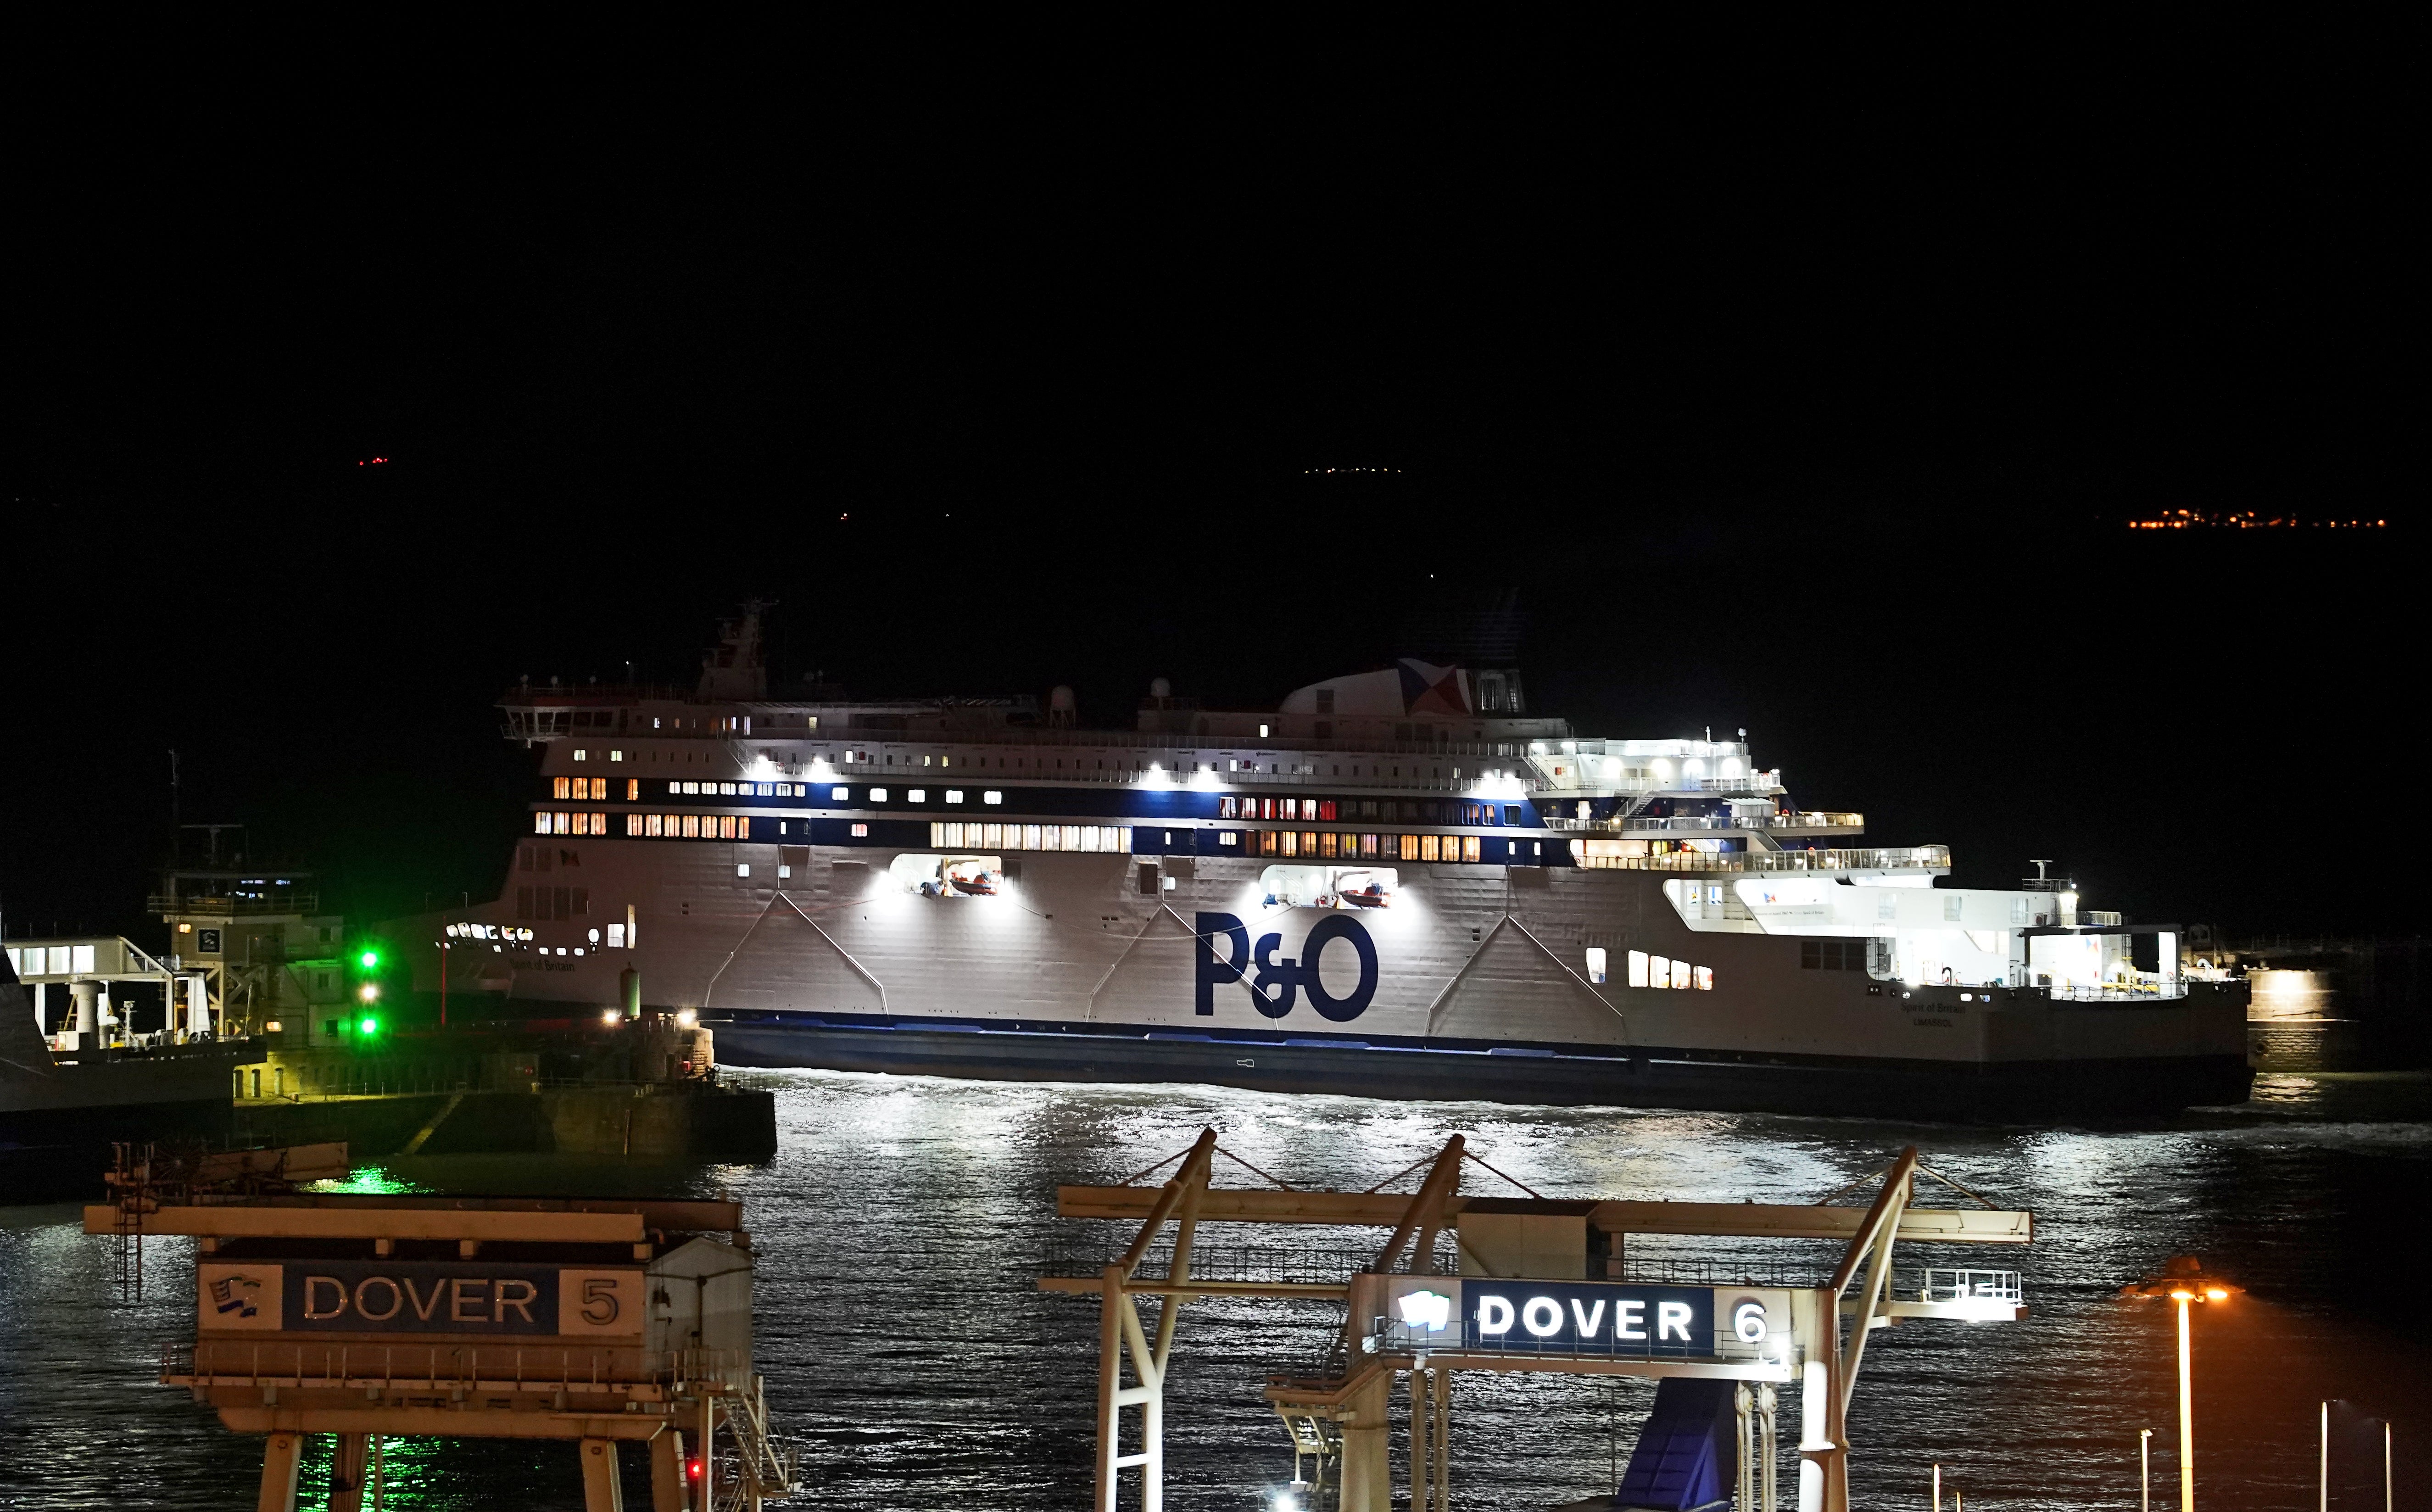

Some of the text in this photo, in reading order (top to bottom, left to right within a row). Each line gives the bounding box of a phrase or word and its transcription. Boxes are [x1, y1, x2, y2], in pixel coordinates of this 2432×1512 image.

[544, 959, 575, 972] Britain
[1195, 912, 1378, 1022] P&O
[1901, 1001, 1966, 1014] Spirit of Britain
[304, 1276, 619, 1326] DOVER 5
[1478, 1295, 1768, 1343] DOVER 6
